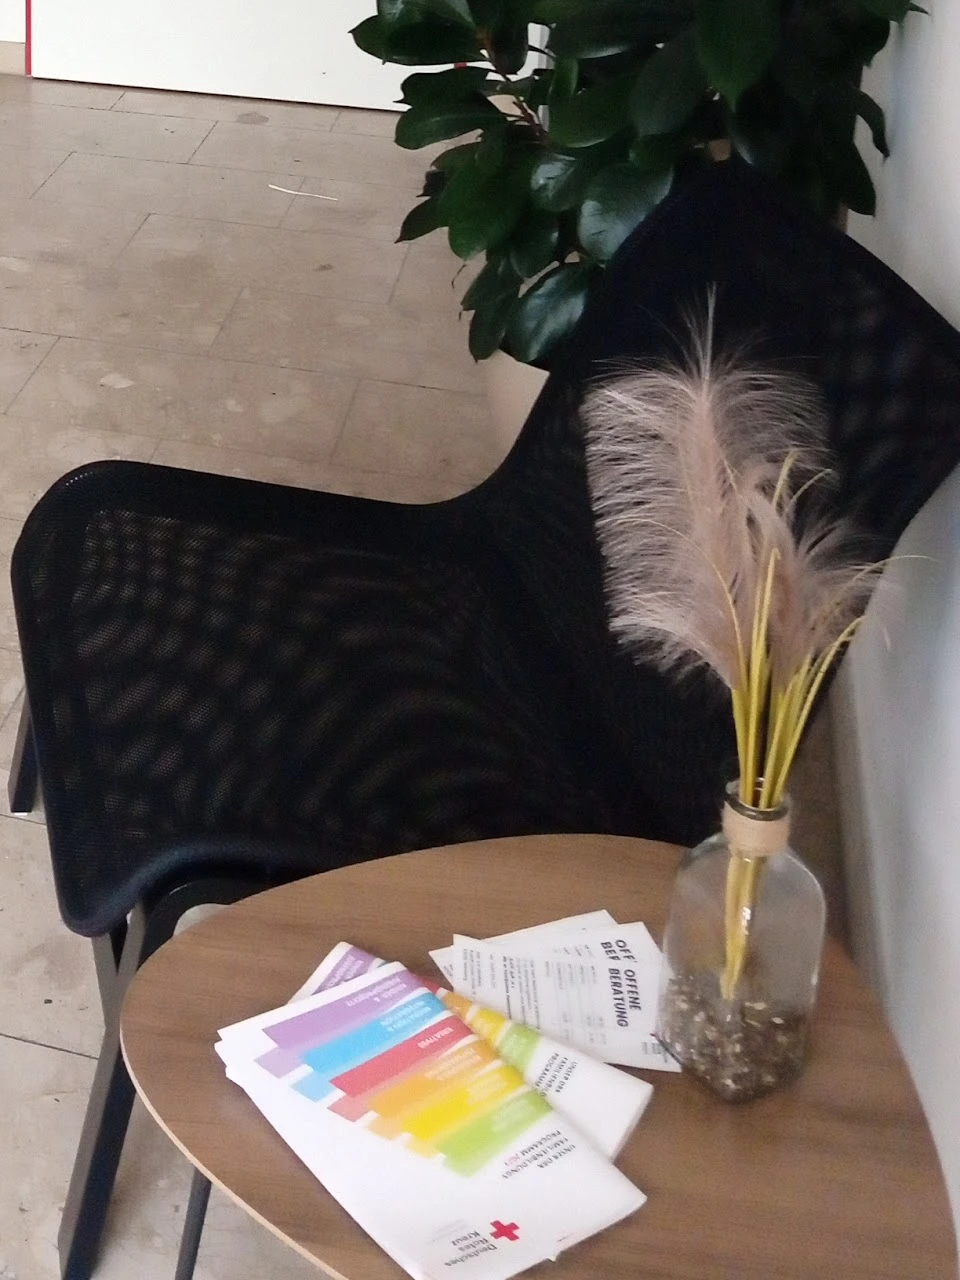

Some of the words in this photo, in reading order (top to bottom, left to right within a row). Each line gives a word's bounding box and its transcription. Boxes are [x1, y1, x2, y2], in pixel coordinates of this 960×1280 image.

[608, 967, 629, 1028] BERATUNG
[624, 968, 642, 1011] OFFENE
[451, 1230, 481, 1246] Kreuz
[458, 1237, 489, 1252] Rotes
[444, 1243, 498, 1267] Deutsches
